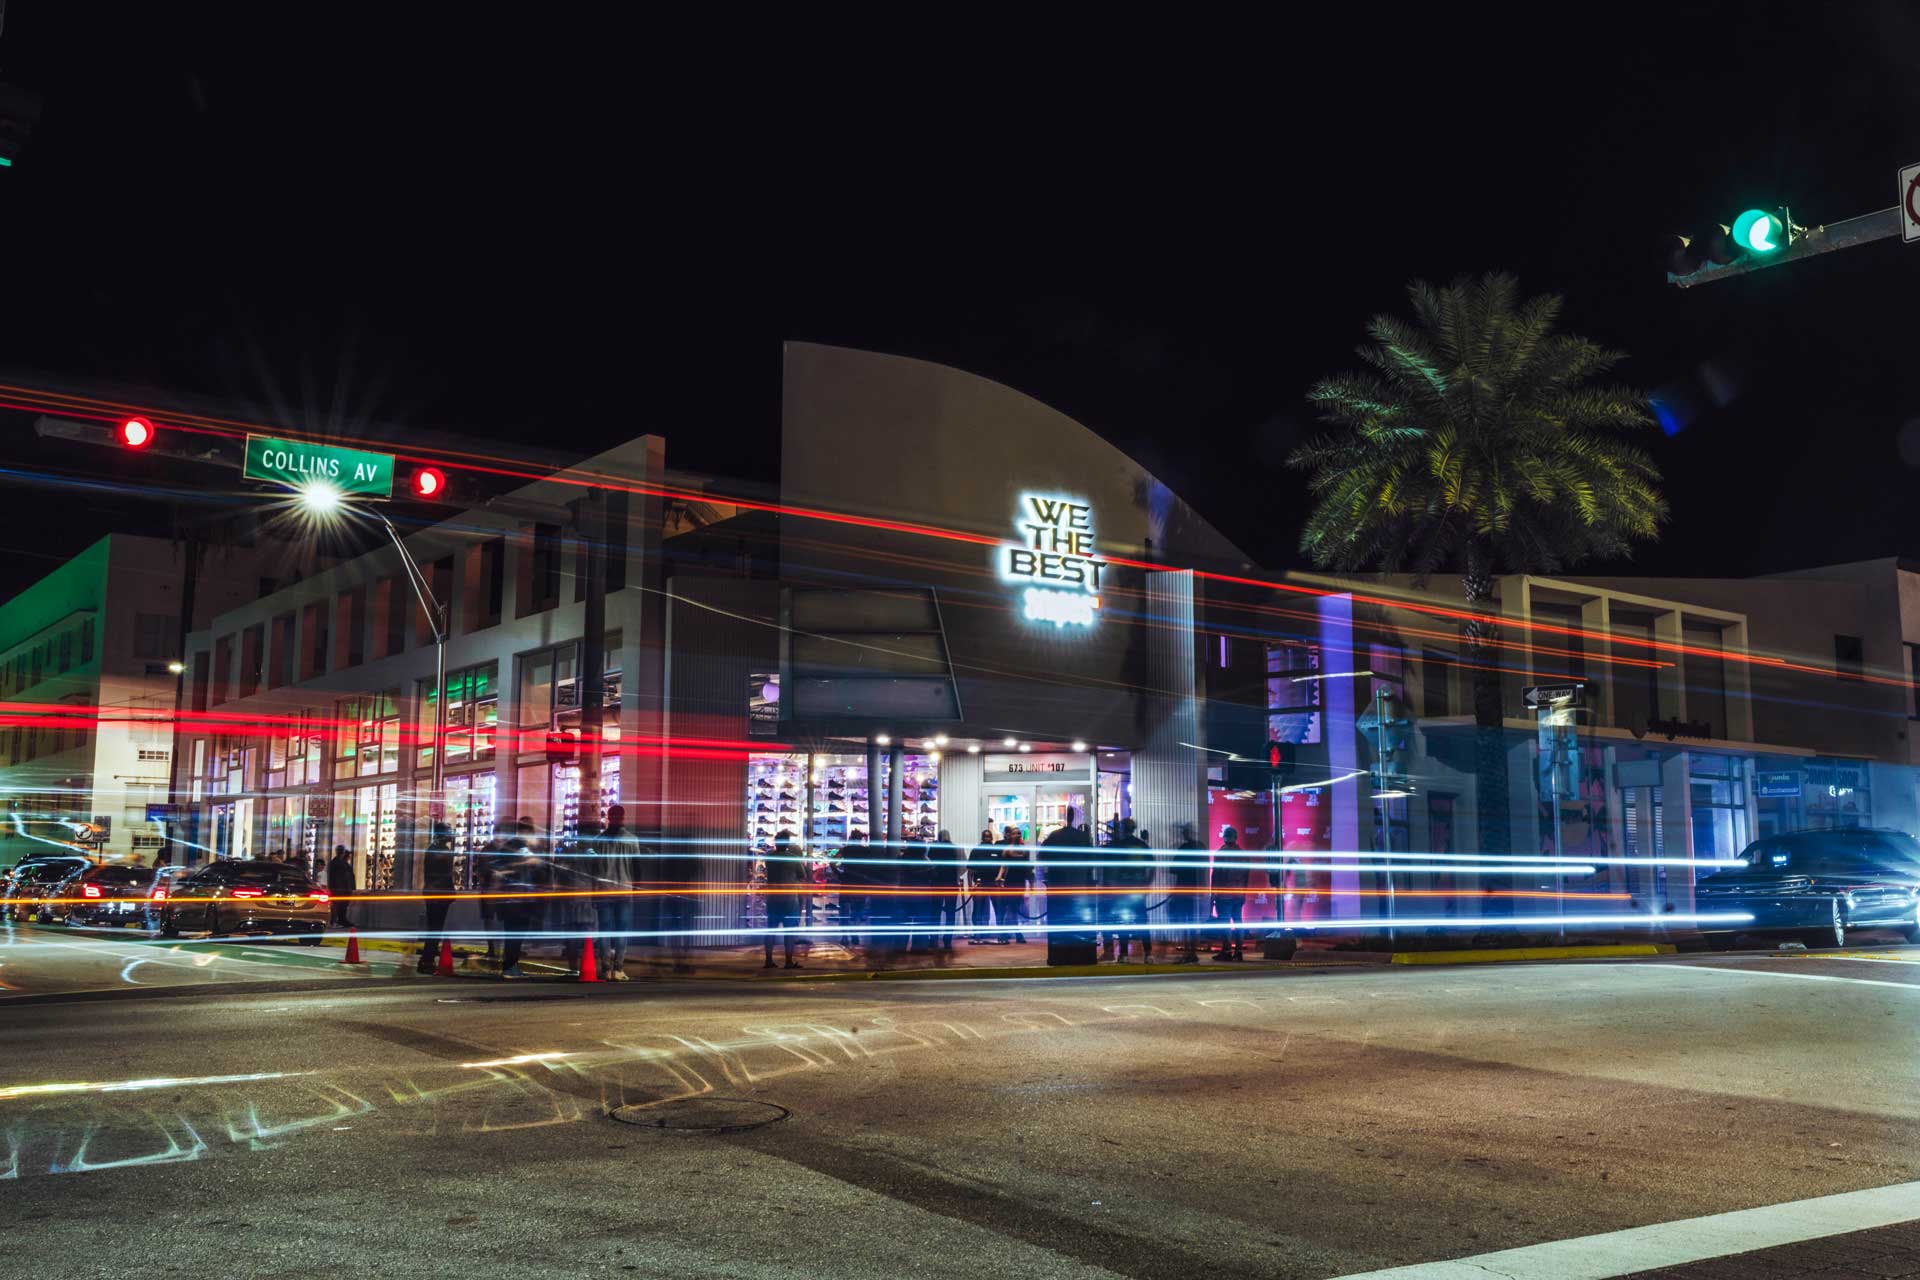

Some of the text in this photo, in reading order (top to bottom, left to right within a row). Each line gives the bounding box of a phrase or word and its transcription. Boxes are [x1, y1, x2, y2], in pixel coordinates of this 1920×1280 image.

[262, 450, 377, 482] COLLINS AV
[1030, 497, 1091, 530] WE
[1025, 524, 1095, 558] THE
[1010, 548, 1108, 590] BEST
[1538, 692, 1553, 700] ONE
[1008, 763, 1023, 773] 673
